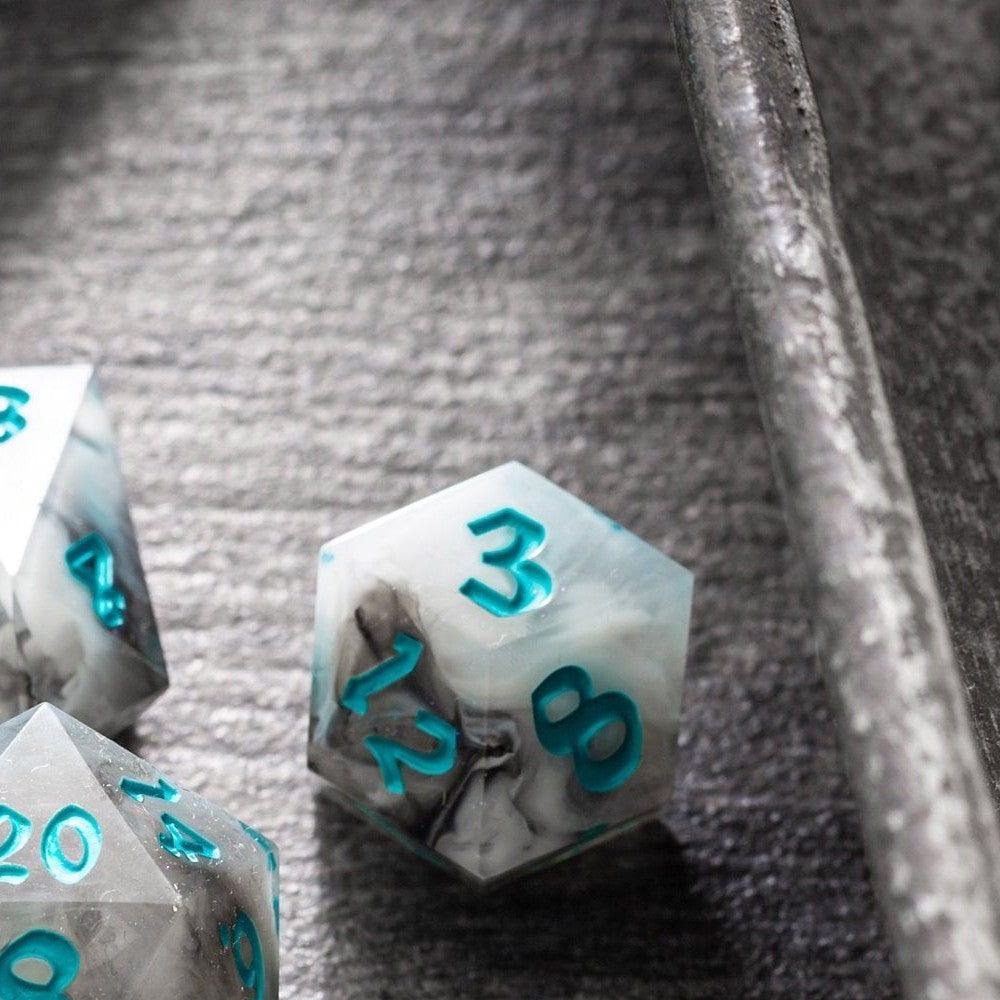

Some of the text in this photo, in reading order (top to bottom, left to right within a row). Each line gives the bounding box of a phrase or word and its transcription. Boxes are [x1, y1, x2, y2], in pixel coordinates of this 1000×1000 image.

[64, 530, 128, 630] 4
[458, 507, 554, 619] 3
[341, 631, 459, 797] 12
[530, 664, 644, 793] 8
